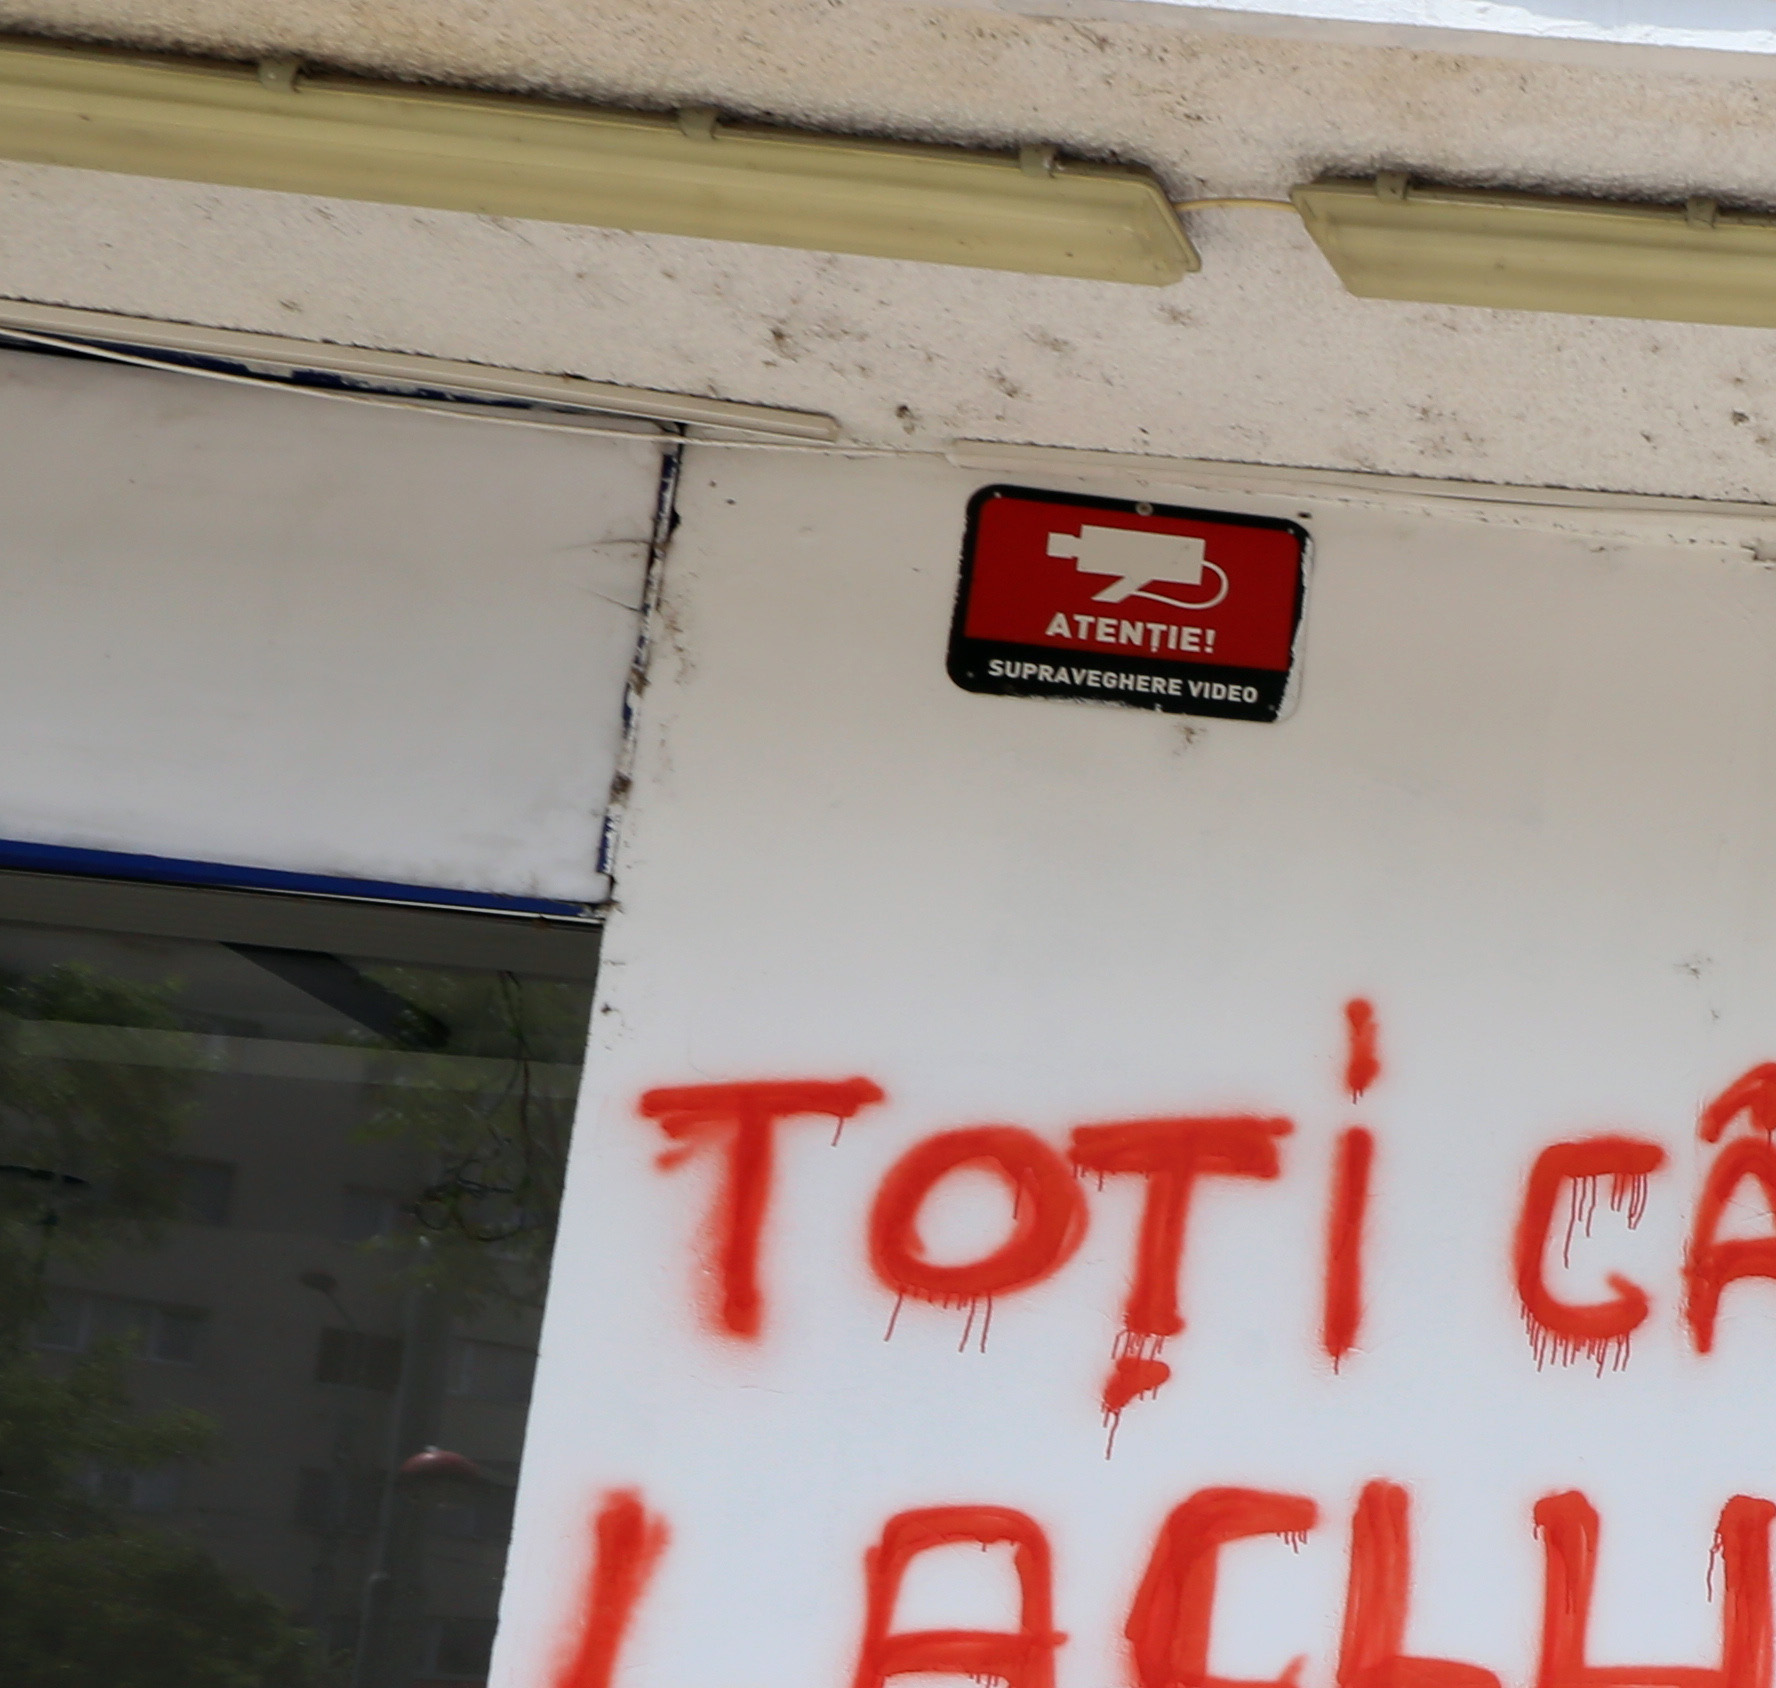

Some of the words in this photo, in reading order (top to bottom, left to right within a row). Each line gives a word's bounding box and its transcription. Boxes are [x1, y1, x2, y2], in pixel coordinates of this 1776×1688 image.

[1045, 611, 1217, 654] ATENȚIE!
[987, 658, 1182, 697] SUPRAVEGHERE
[1187, 679, 1259, 704] VIDEO
